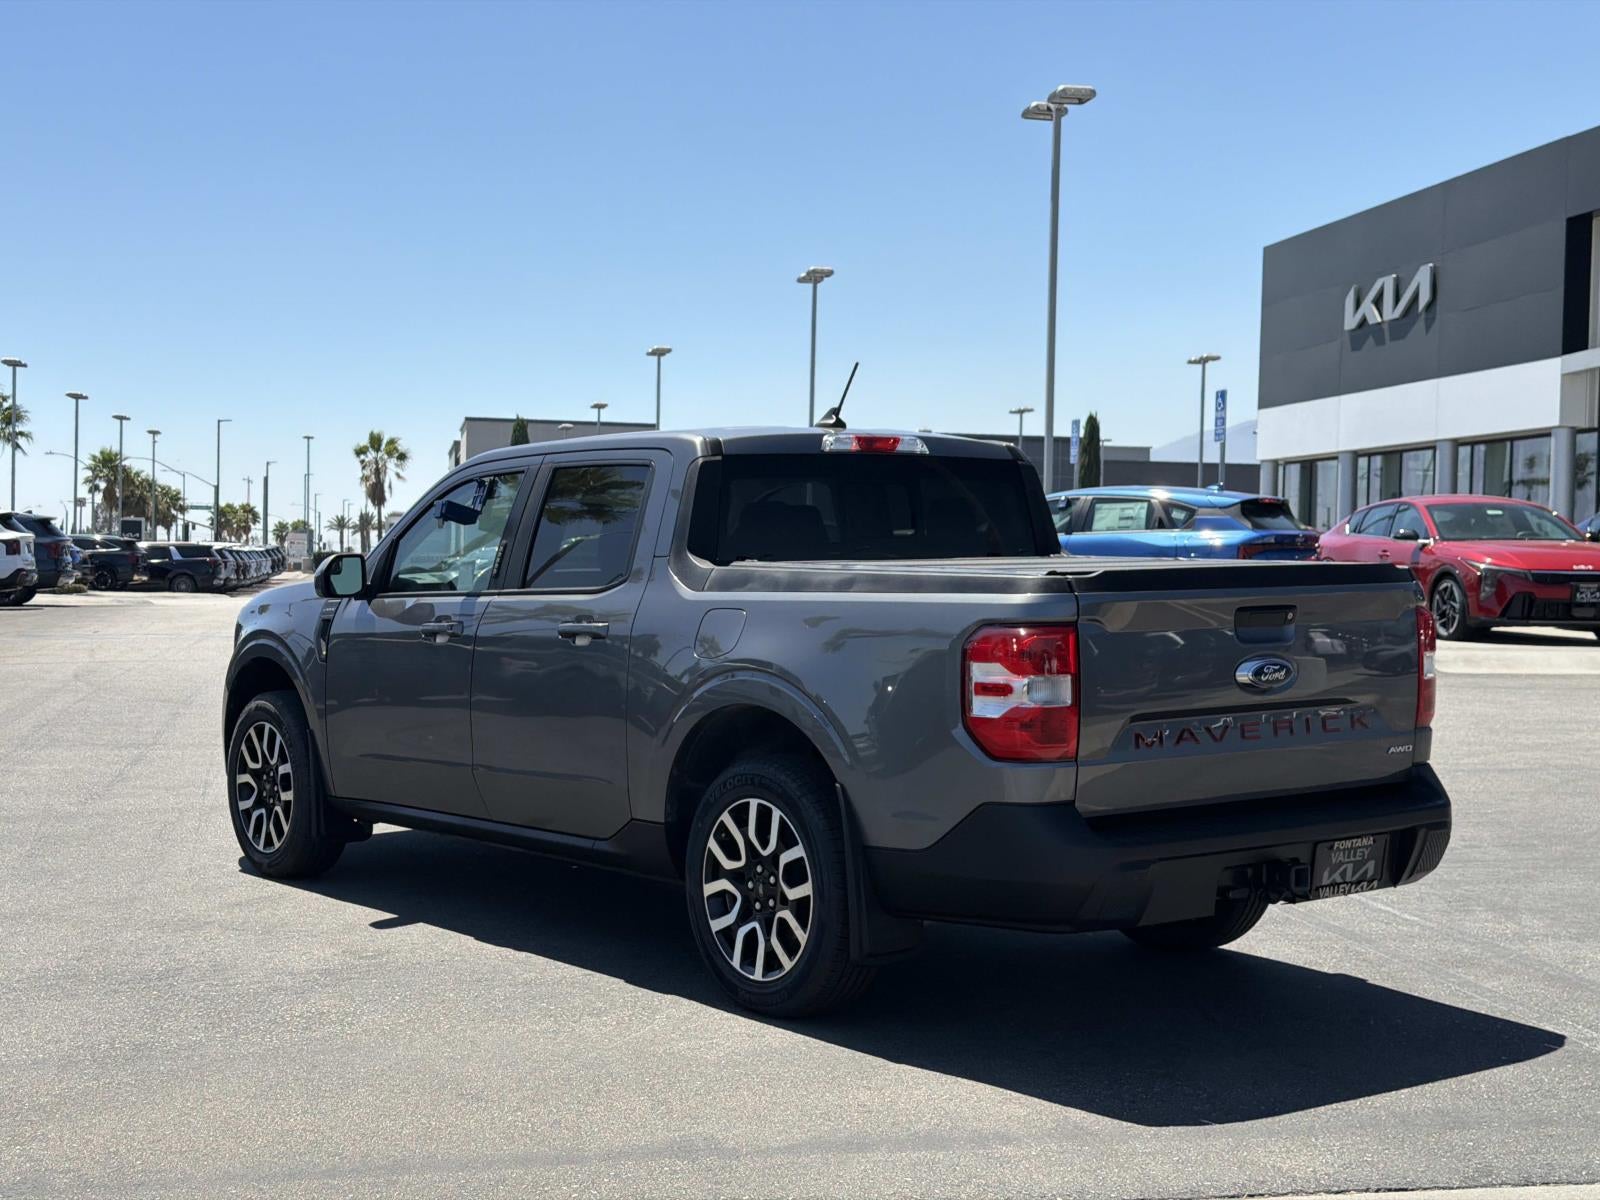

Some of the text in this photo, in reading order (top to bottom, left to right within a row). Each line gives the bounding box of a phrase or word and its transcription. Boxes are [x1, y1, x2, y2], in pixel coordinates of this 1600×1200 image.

[1344, 263, 1434, 331] KIA
[1261, 665, 1287, 681] Ford
[1134, 711, 1369, 751] MAVERICK
[1388, 743, 1413, 754] AWD
[1334, 836, 1374, 850] FONTANA
[1332, 847, 1371, 864] VALLEY
[1322, 860, 1375, 885] KIA
[1319, 883, 1351, 899] VALLEY
